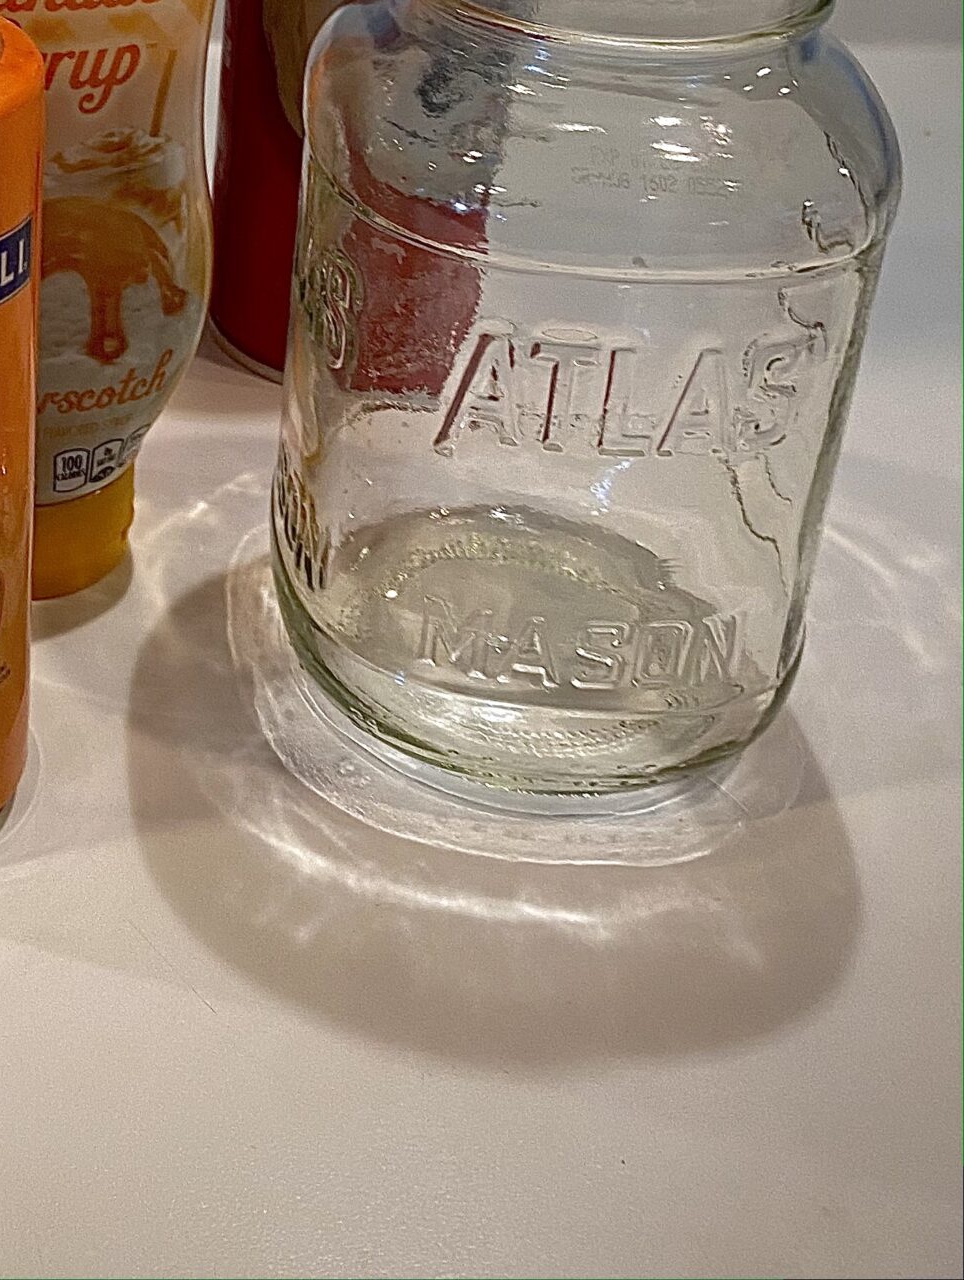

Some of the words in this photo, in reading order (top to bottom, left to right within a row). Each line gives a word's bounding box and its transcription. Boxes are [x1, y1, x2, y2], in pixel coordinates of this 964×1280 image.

[41, 43, 142, 114] rup
[434, 320, 821, 460] ATLAS
[61, 455, 83, 470] 100
[418, 594, 743, 690] MASON
